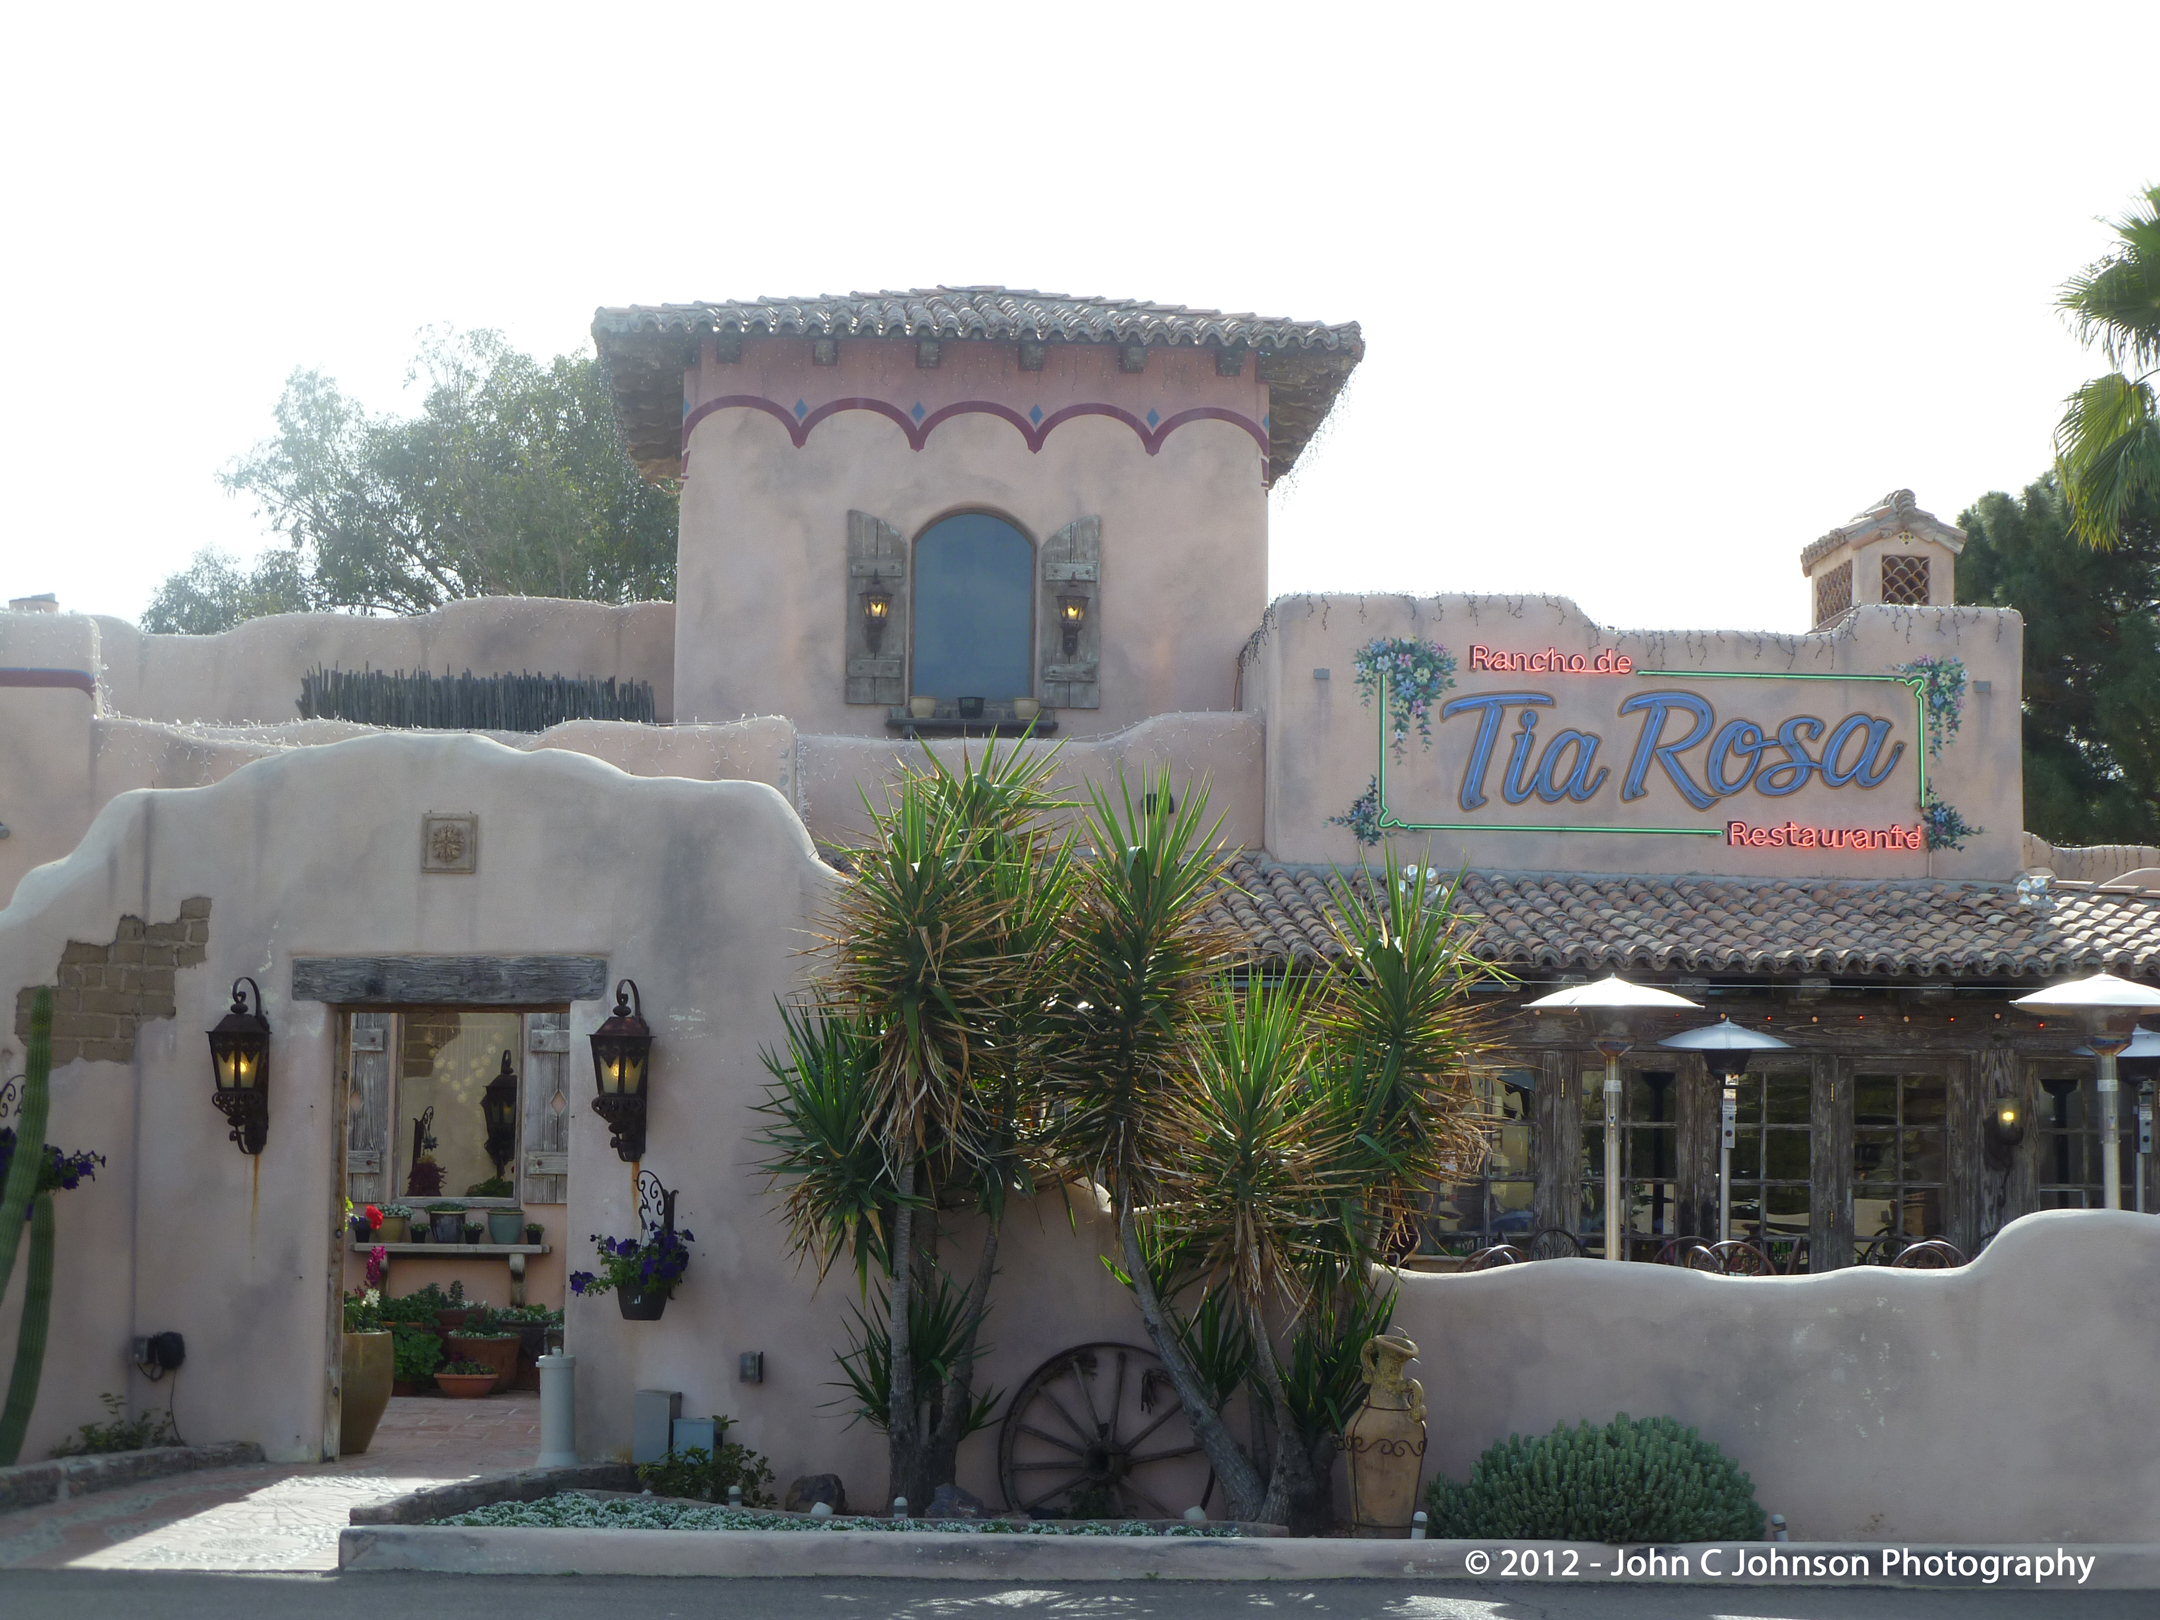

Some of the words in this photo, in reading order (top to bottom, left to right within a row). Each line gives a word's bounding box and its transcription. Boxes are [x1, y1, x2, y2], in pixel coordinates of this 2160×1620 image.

[1469, 645, 1586, 673] Rancho
[1594, 648, 1632, 674] de
[1441, 692, 1608, 812] Tia
[1618, 690, 1904, 811] Rosa
[1727, 820, 1922, 850] Restaurante
